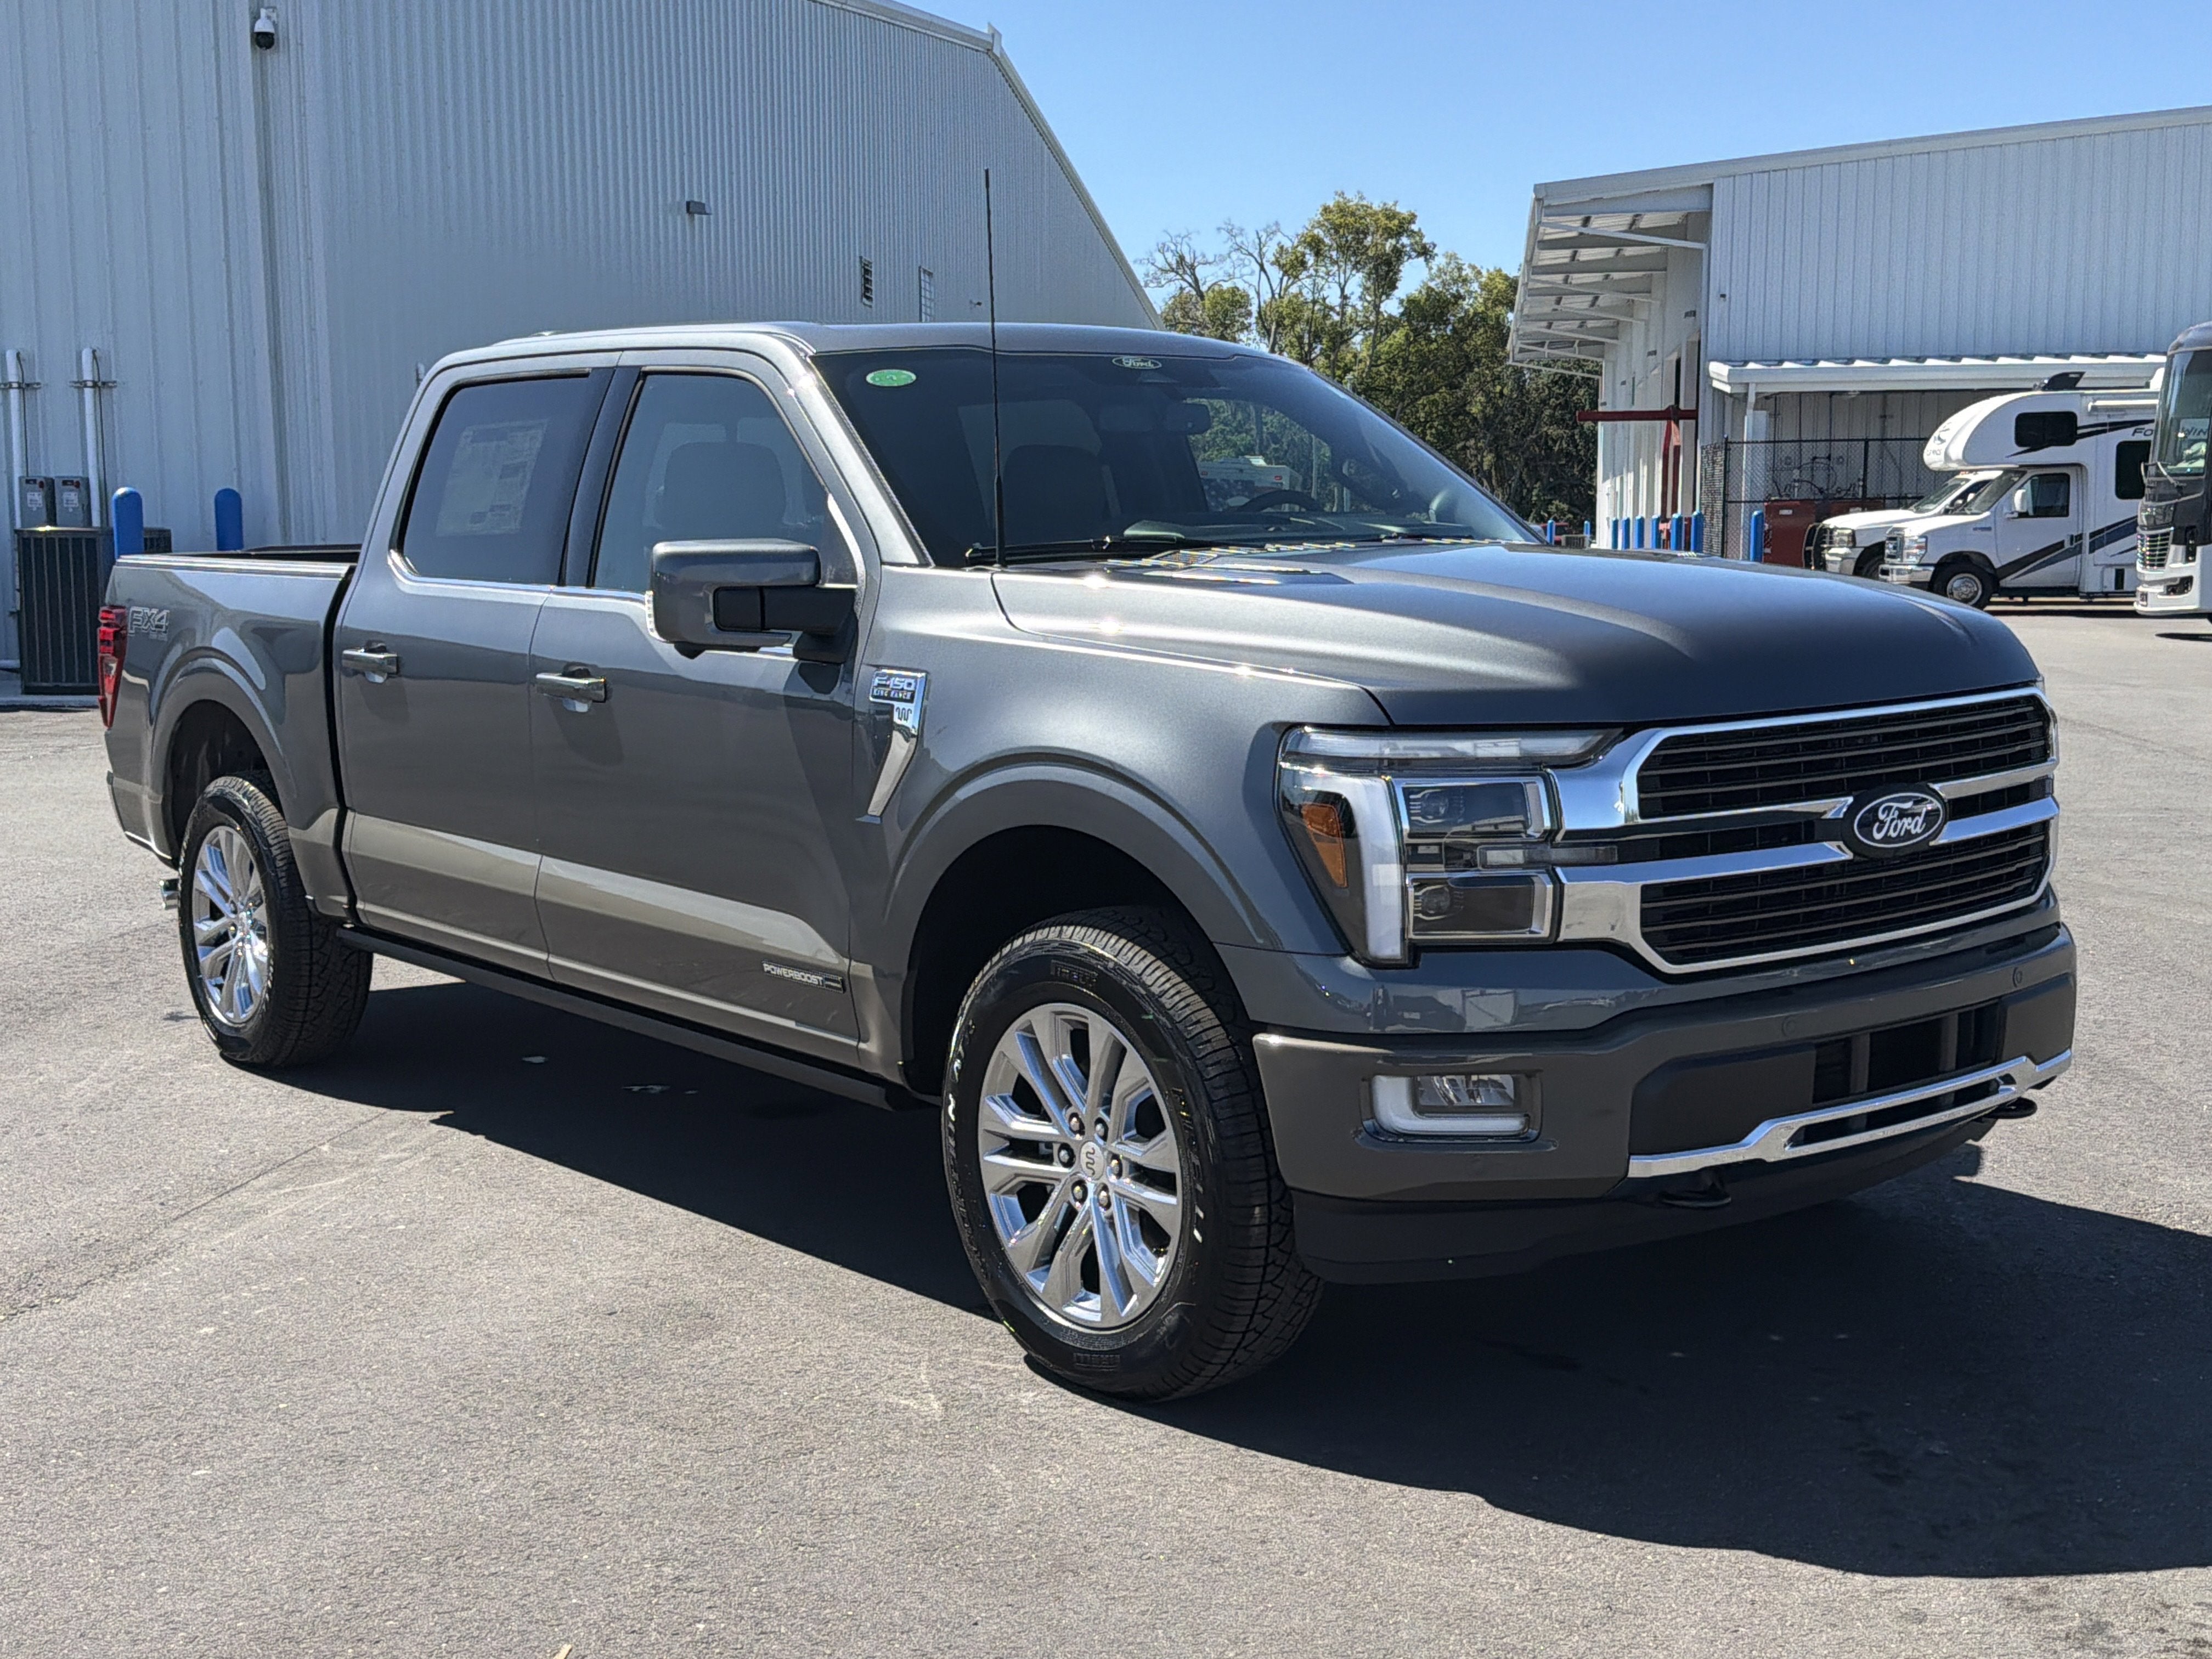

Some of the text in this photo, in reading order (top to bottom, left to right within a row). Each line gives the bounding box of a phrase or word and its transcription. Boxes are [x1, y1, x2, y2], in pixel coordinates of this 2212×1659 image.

[1122, 357, 1154, 368] Ford
[128, 606, 171, 636] FX4
[1872, 801, 1927, 840] Ford
[762, 963, 823, 986] POWERBOOST
